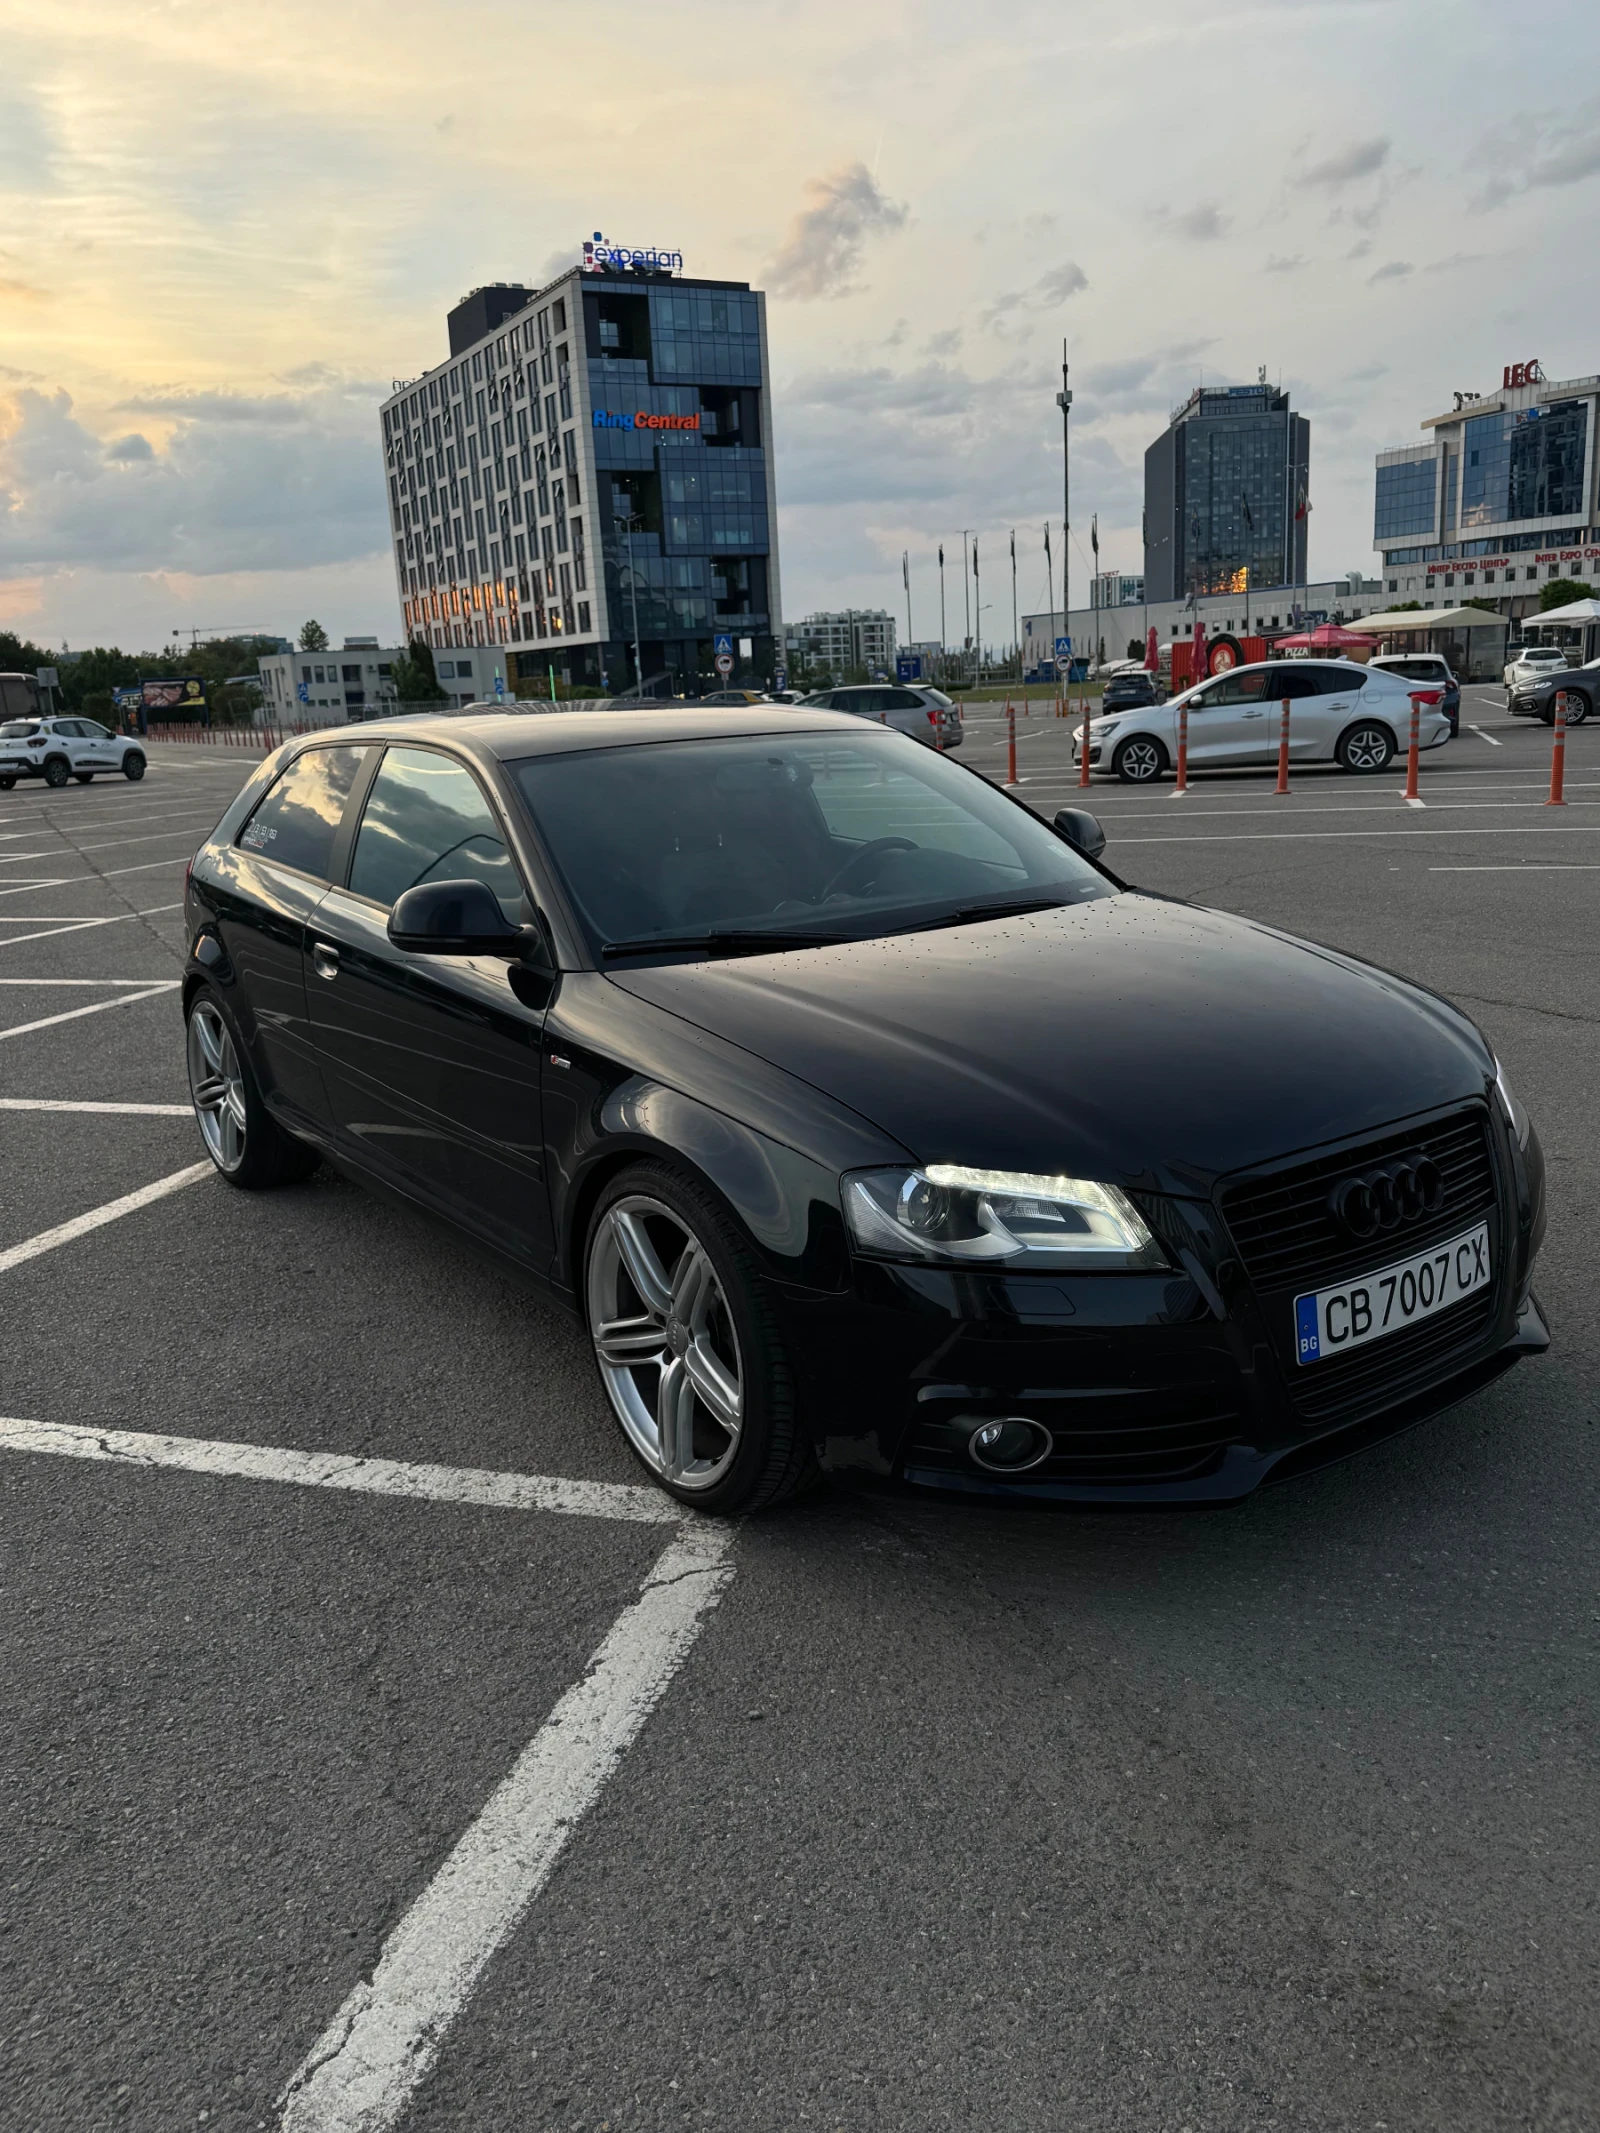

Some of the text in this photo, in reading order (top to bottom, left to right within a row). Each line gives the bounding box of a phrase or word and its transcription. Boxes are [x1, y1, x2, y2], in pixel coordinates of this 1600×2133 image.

[594, 247, 683, 271] experian
[593, 409, 700, 432] RingCentral
[1535, 553, 1557, 563] INTER
[1560, 550, 1582, 560] EXPO
[1285, 647, 1308, 657] PIZZA
[1325, 1234, 1486, 1344] CB 7007 CX
[1300, 1336, 1318, 1353] BG
